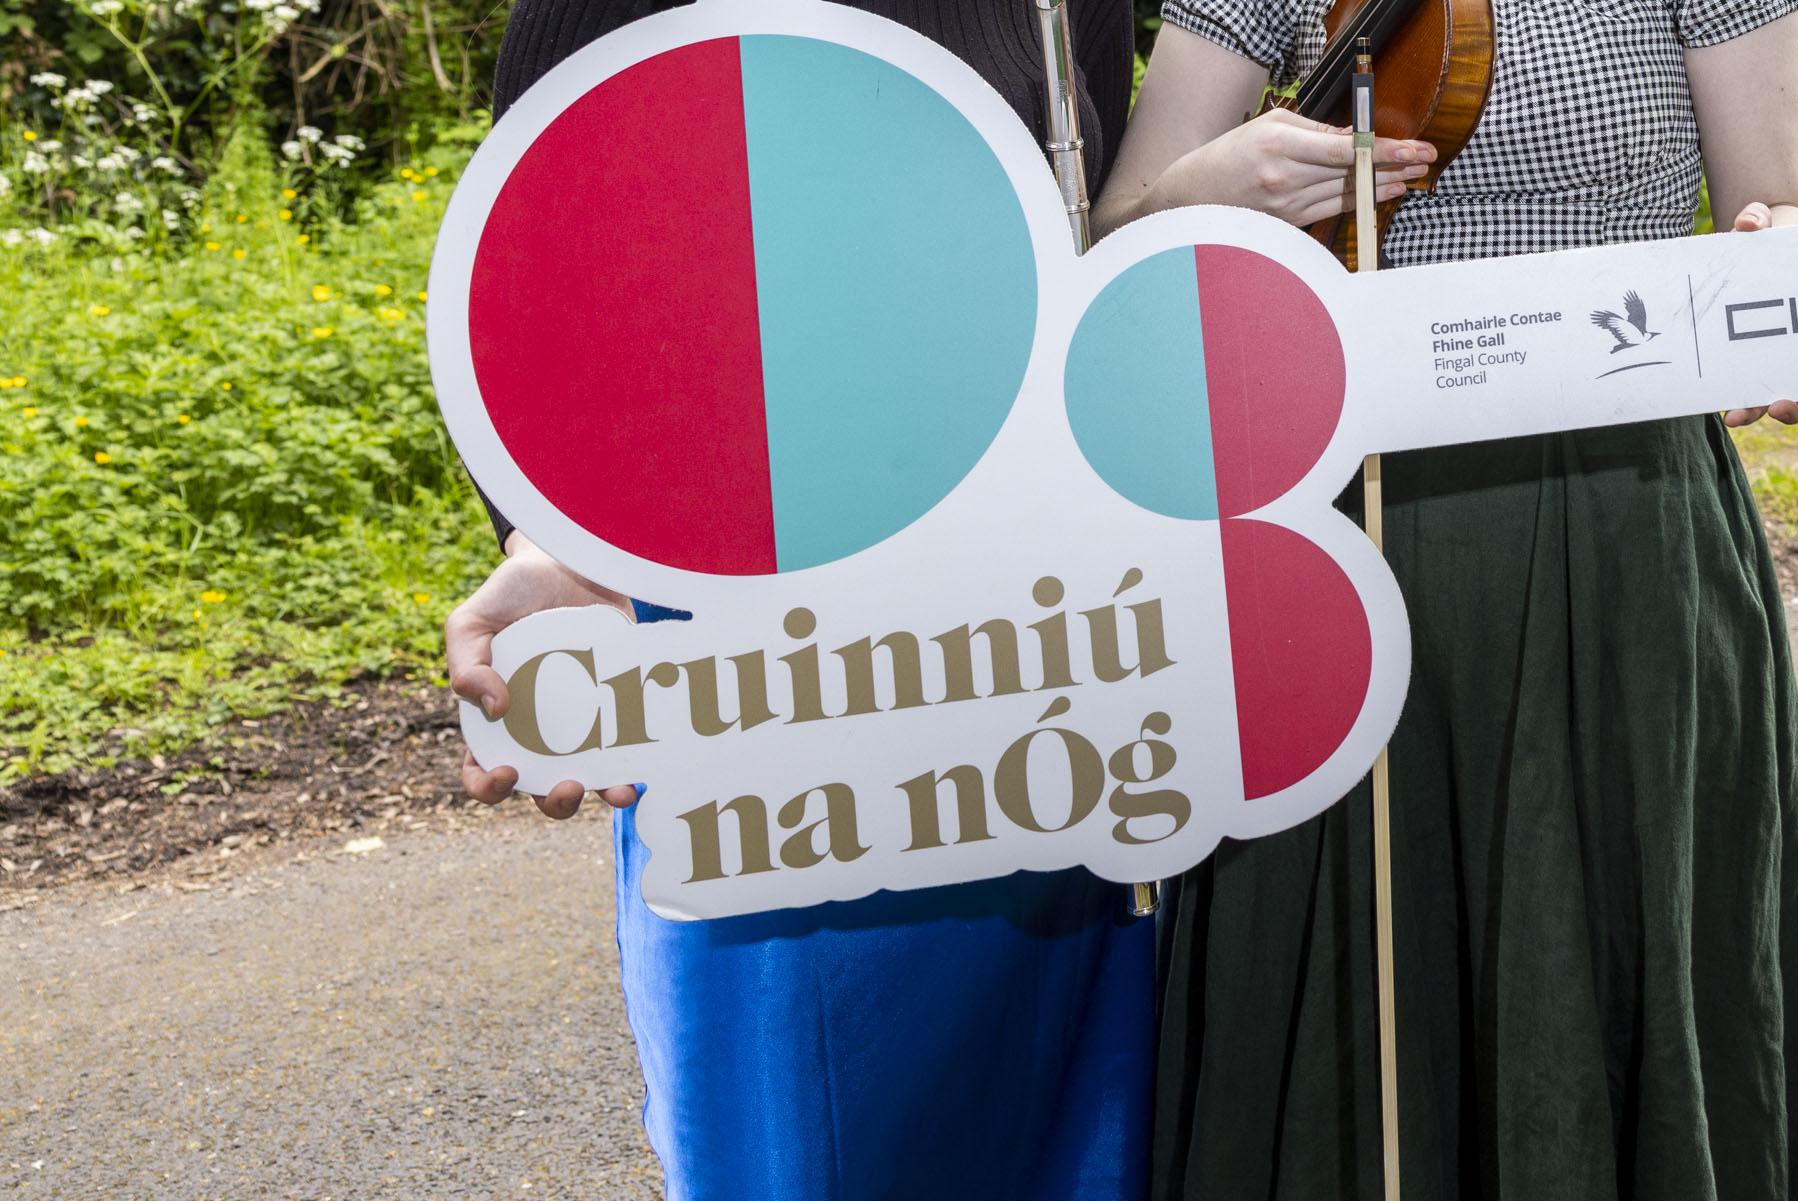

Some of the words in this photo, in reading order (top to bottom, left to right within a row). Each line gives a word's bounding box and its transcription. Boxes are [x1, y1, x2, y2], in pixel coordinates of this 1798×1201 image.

[1431, 316, 1507, 335] Comhairle
[1510, 311, 1562, 326] Contae
[1433, 339, 1474, 353] Fhine
[1477, 333, 1505, 348] Gall
[1434, 354, 1475, 372] Fingal
[1478, 351, 1527, 366] County
[1436, 371, 1487, 389] Council
[502, 567, 1178, 757] Cruinniú
[676, 780, 872, 885] na
[896, 696, 1192, 852] nÓg
